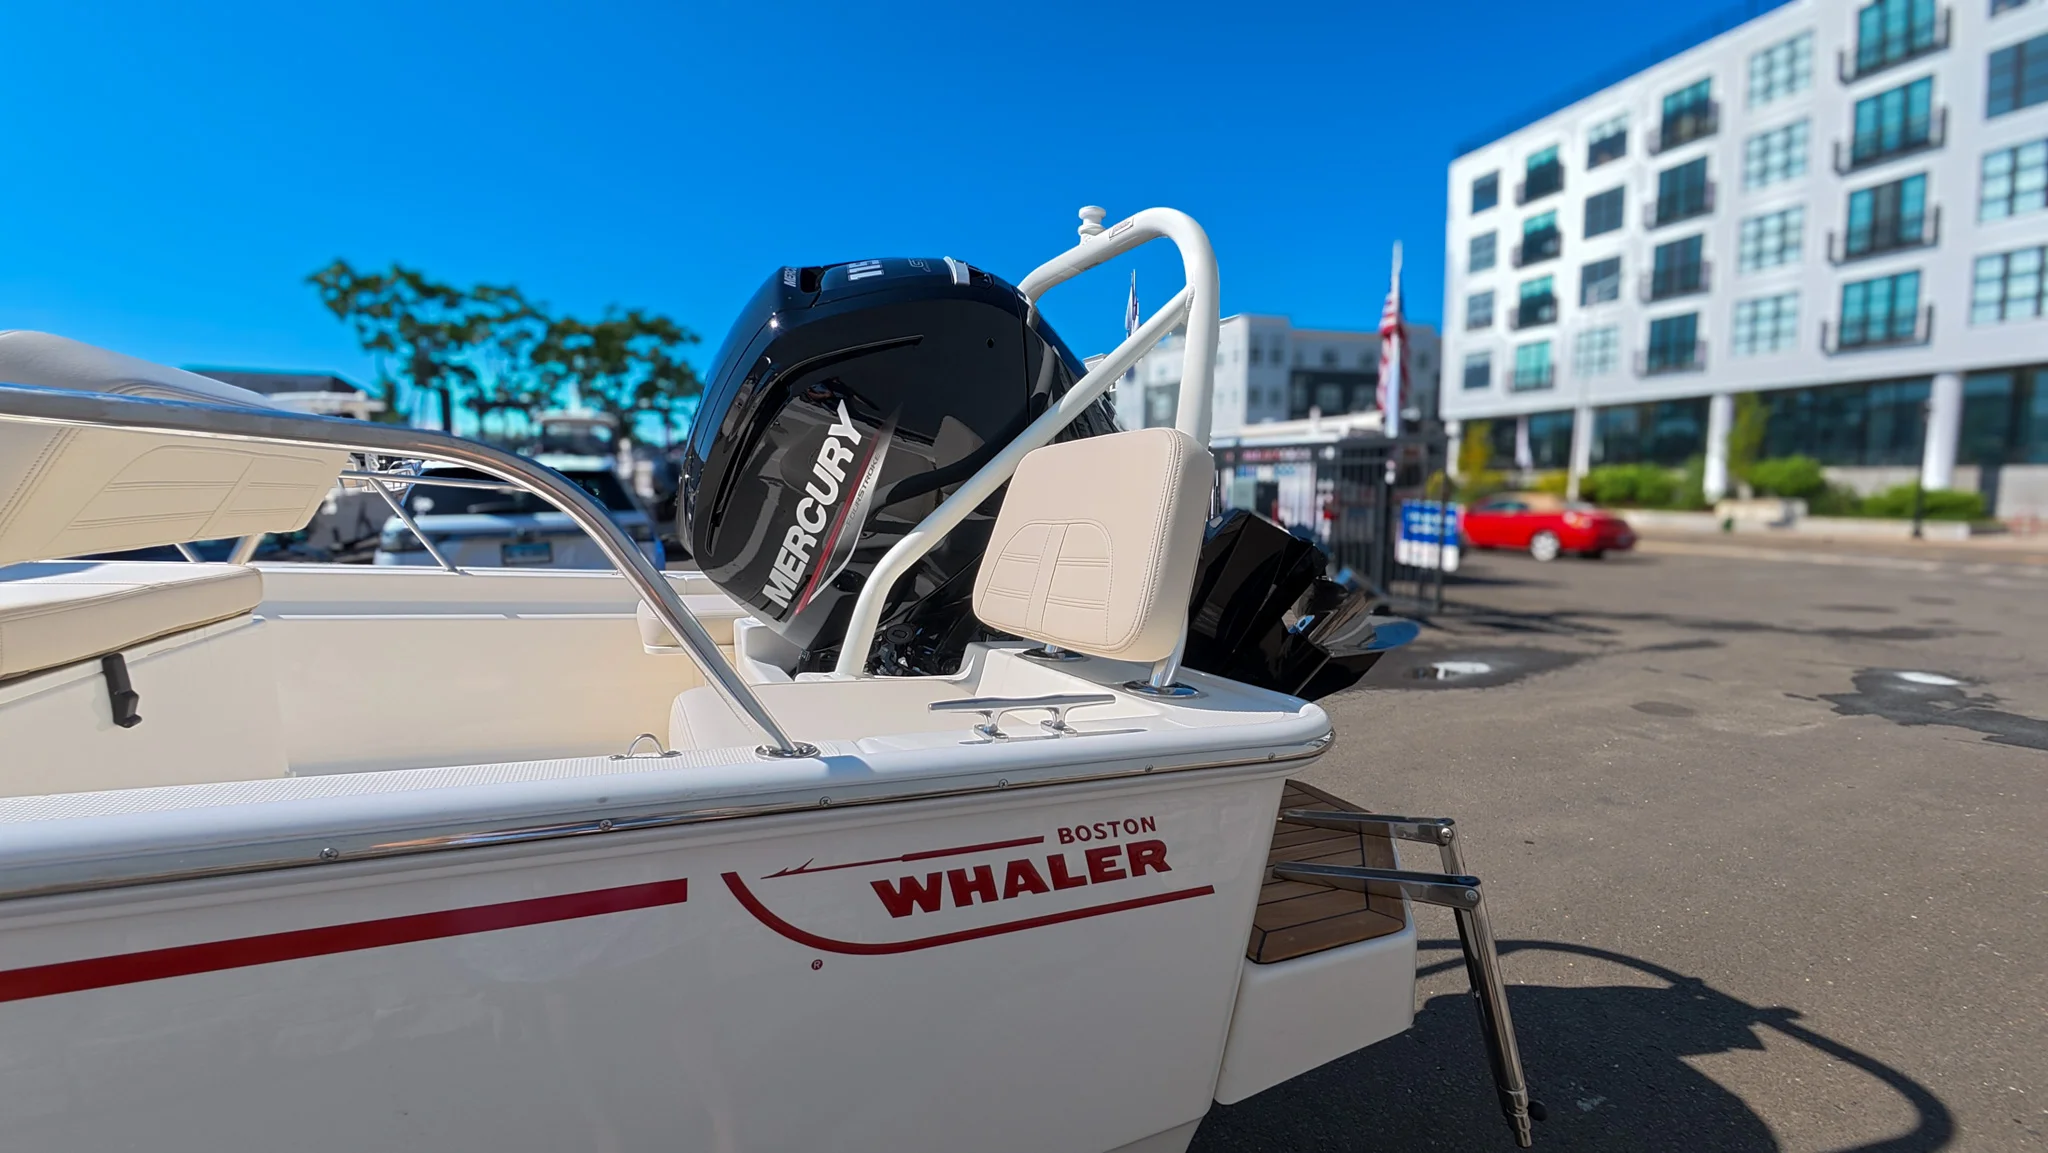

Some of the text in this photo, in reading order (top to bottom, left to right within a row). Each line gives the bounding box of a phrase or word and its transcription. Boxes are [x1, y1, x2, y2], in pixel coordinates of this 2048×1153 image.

[762, 399, 862, 609] MERCURY
[846, 453, 881, 528] FOURSTROKE
[1057, 816, 1157, 845] BOSTON
[870, 839, 1172, 918] WHALER
